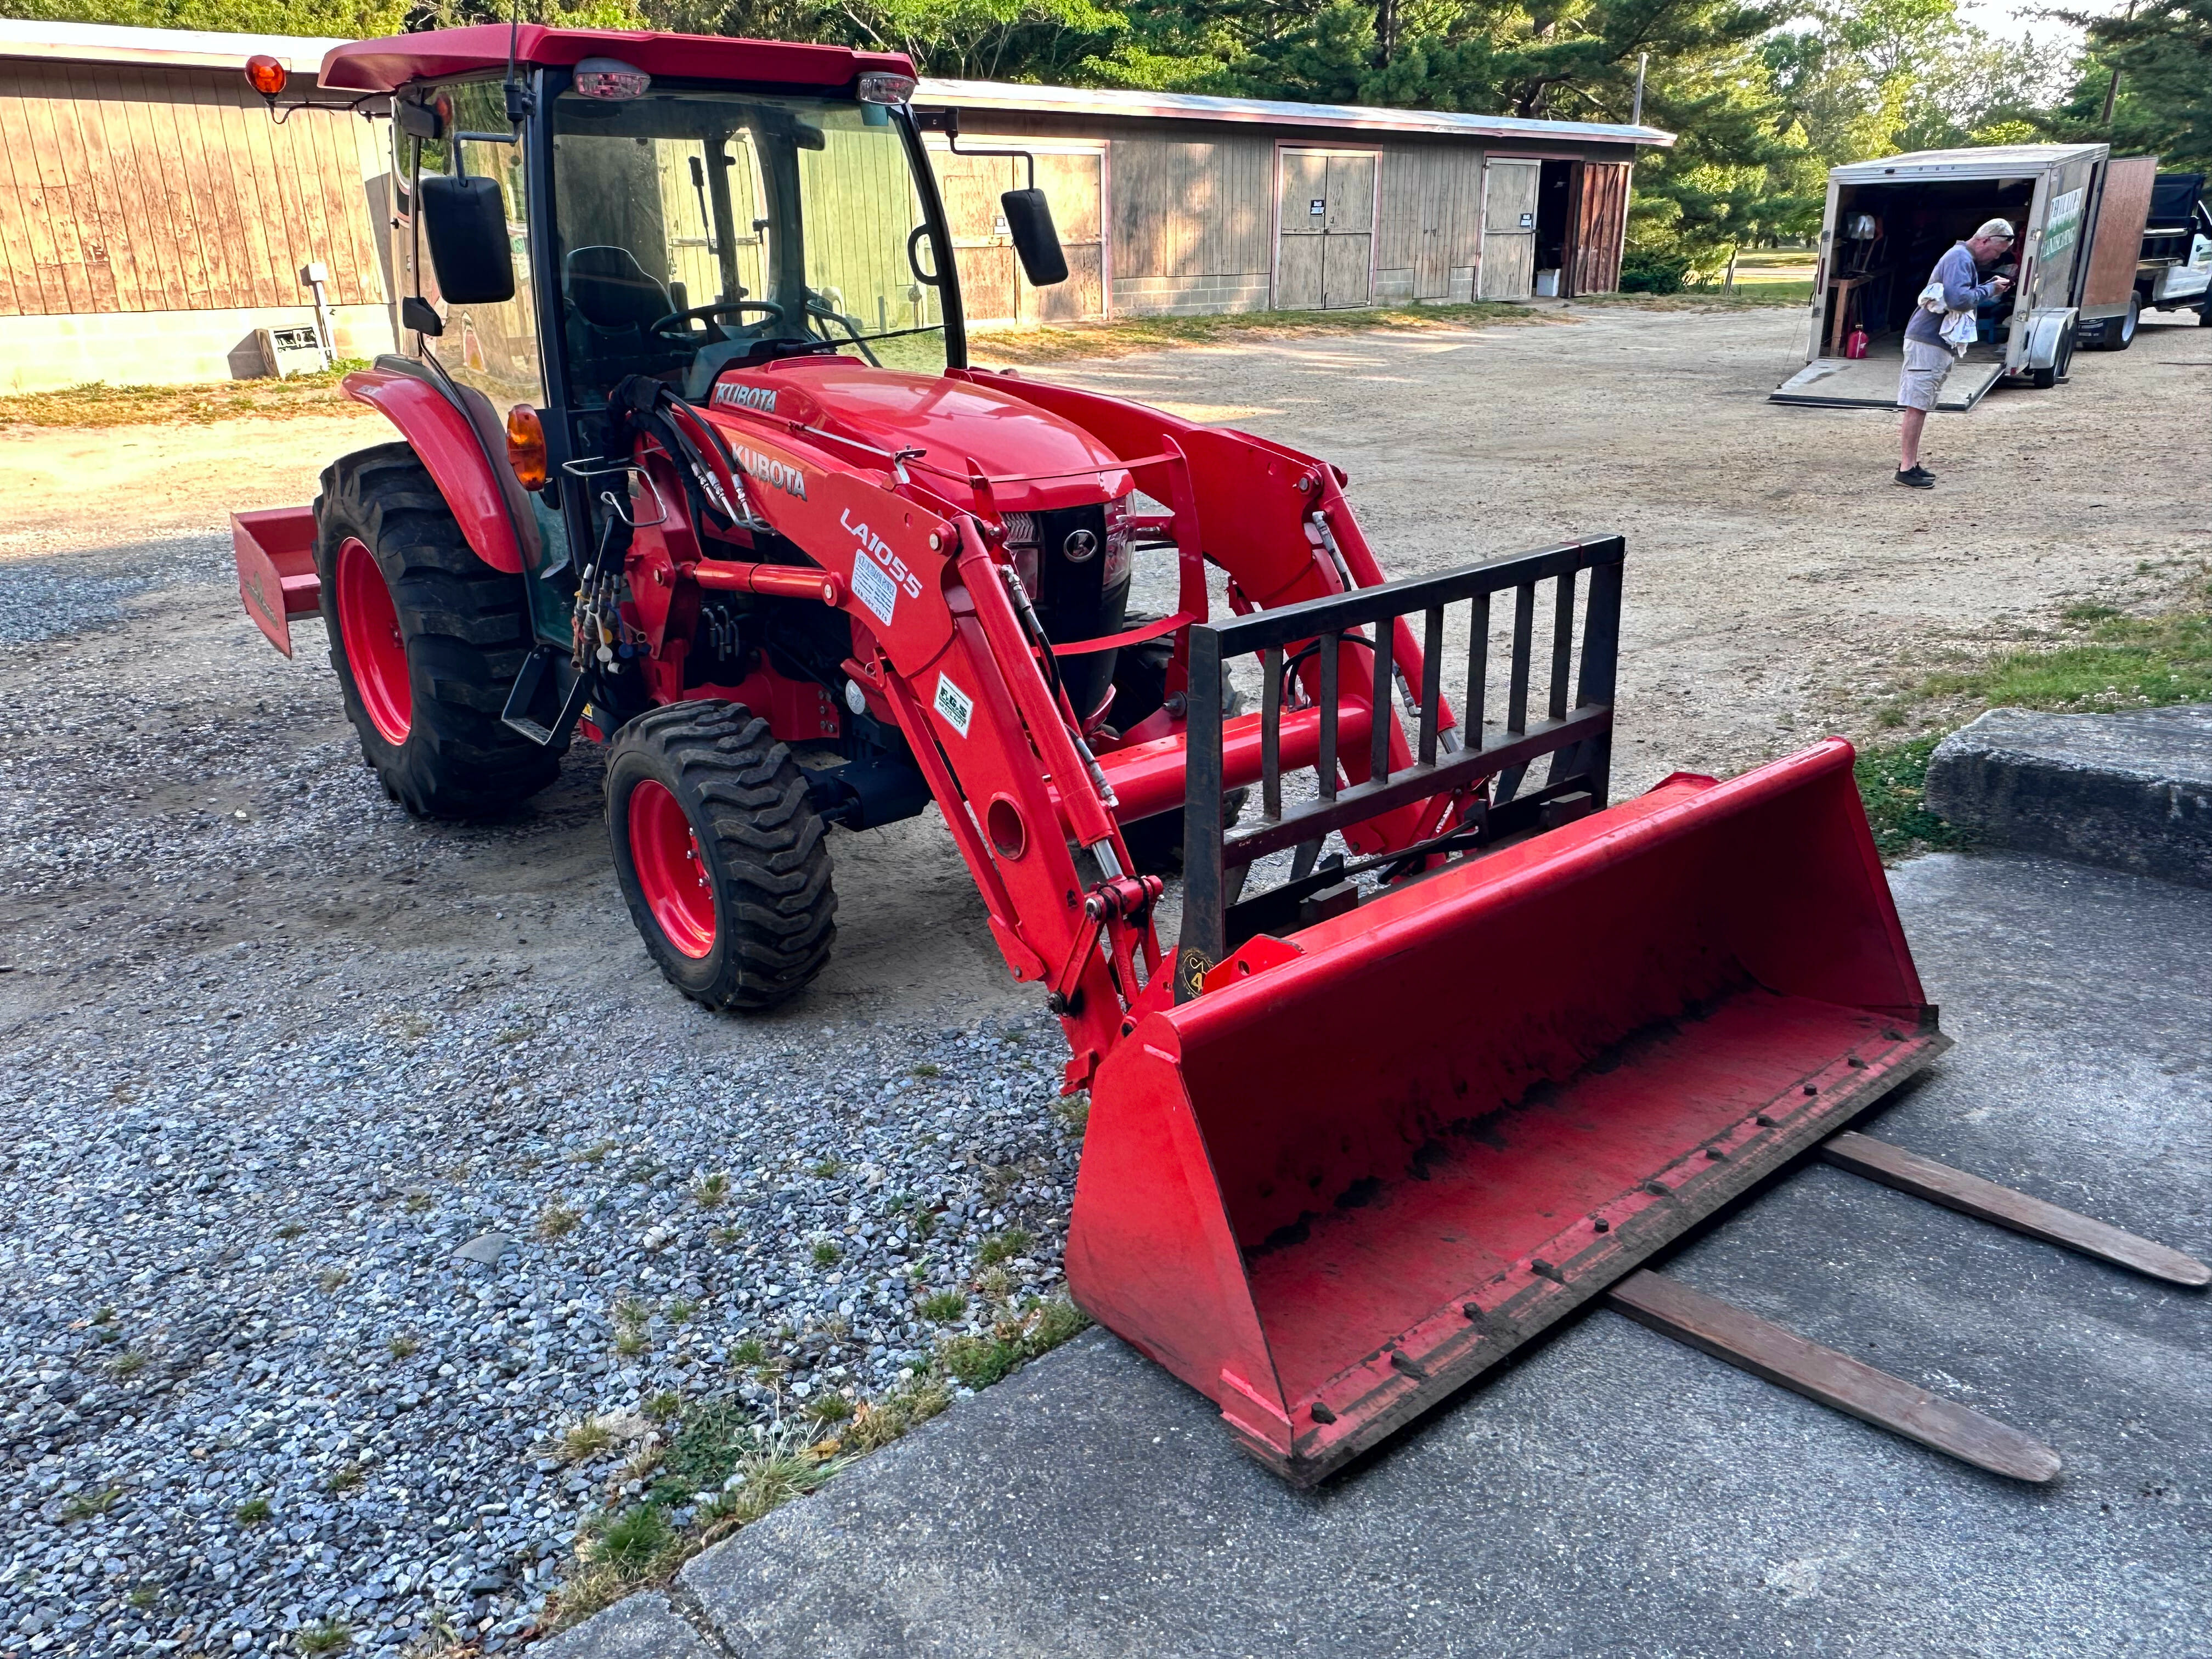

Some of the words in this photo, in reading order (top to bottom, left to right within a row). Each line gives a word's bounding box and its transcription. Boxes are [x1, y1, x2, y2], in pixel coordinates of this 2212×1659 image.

[715, 383, 777, 413] KUBOTA
[731, 442, 808, 502] KUBOTA
[840, 507, 923, 599] LA1055
